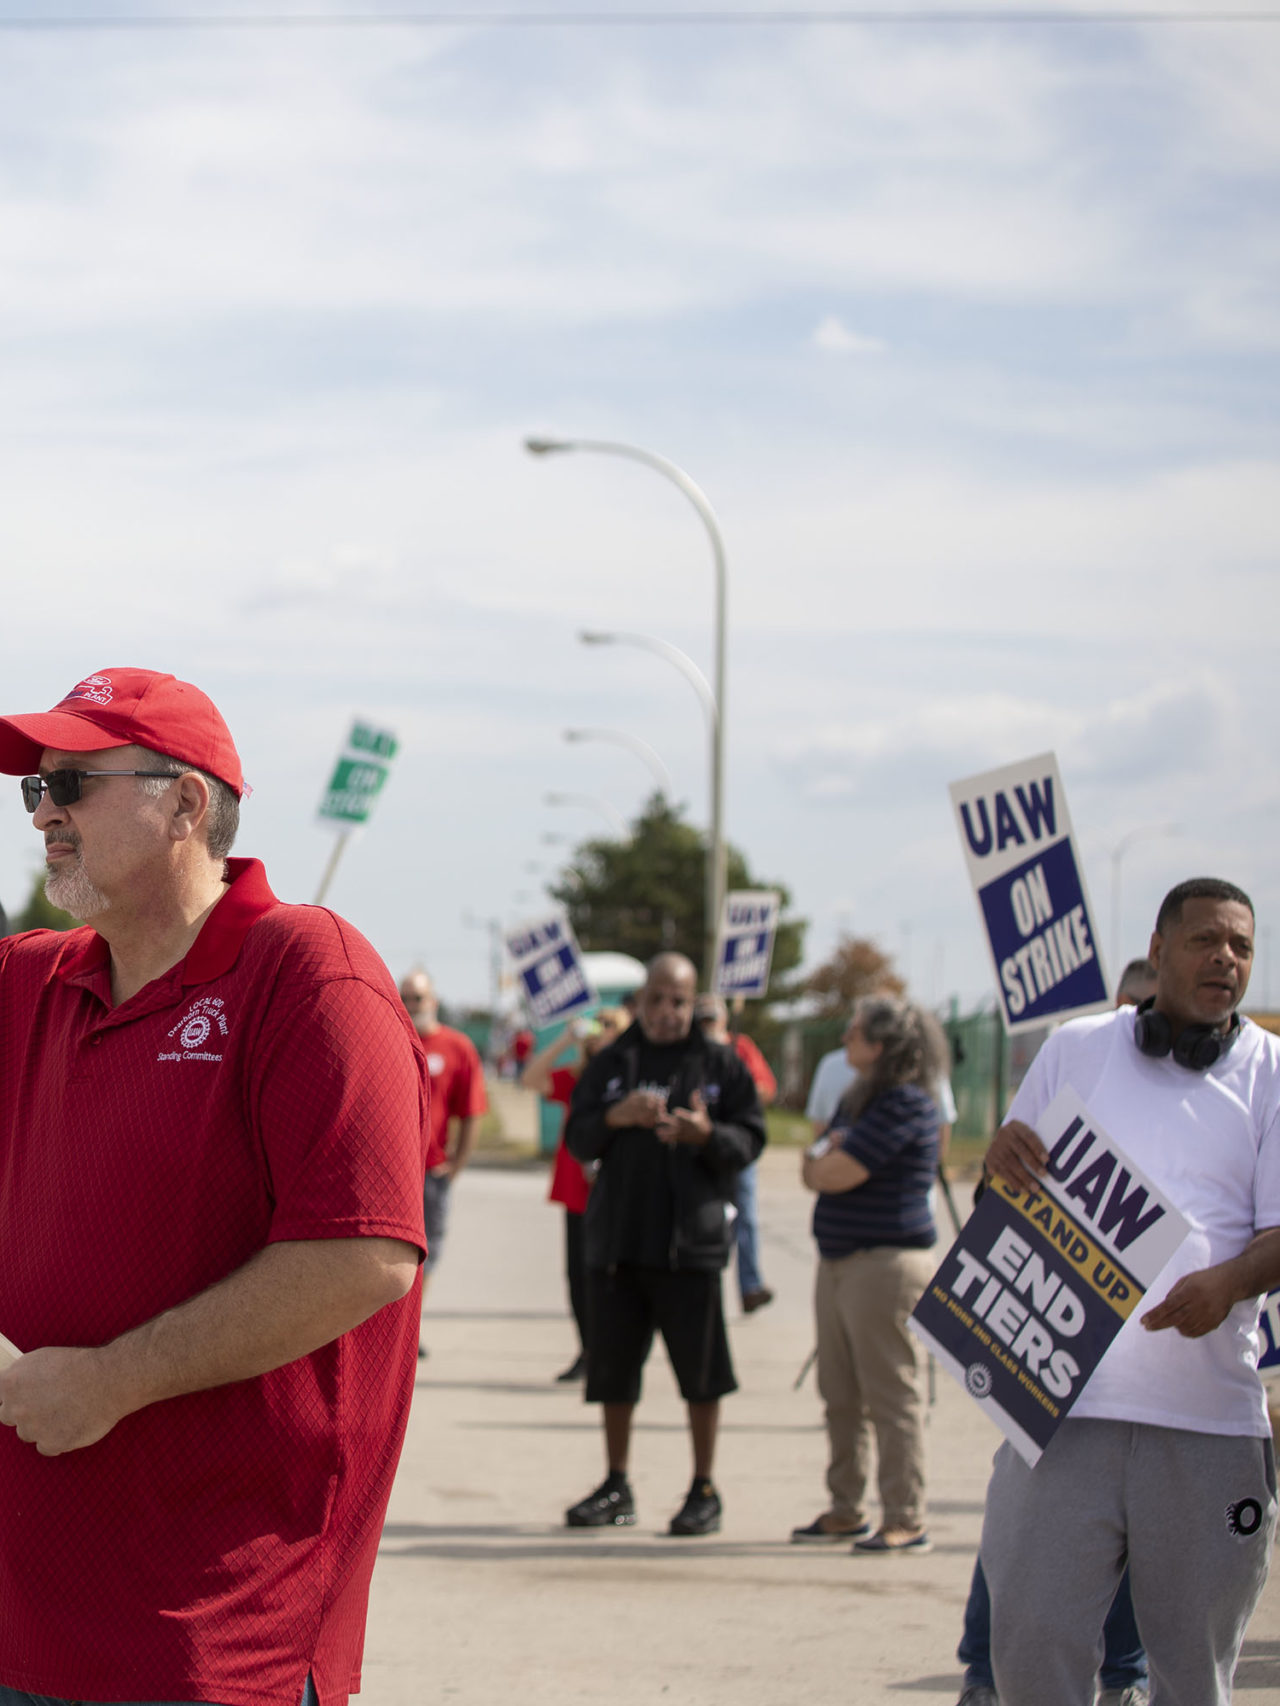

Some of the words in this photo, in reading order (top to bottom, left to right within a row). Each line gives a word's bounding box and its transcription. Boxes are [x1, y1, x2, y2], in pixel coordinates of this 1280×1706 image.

[960, 776, 1057, 857] UAW
[1010, 862, 1053, 937] ON
[1000, 903, 1093, 1015] STRIKE
[168, 1009, 200, 1037] Dearborn
[216, 1014, 229, 1035] Plant
[183, 1050, 222, 1061] Committees
[1047, 1115, 1165, 1254] UAW
[949, 1249, 1081, 1399] TIERS
[987, 1225, 1086, 1338] END
[1092, 1259, 1130, 1301] UP
[932, 1285, 948, 1303] NO
[947, 1299, 974, 1329] MORE
[972, 1324, 992, 1346] 2ND
[990, 1343, 1019, 1374] CLASS
[1018, 1370, 1060, 1418] WORKERS
